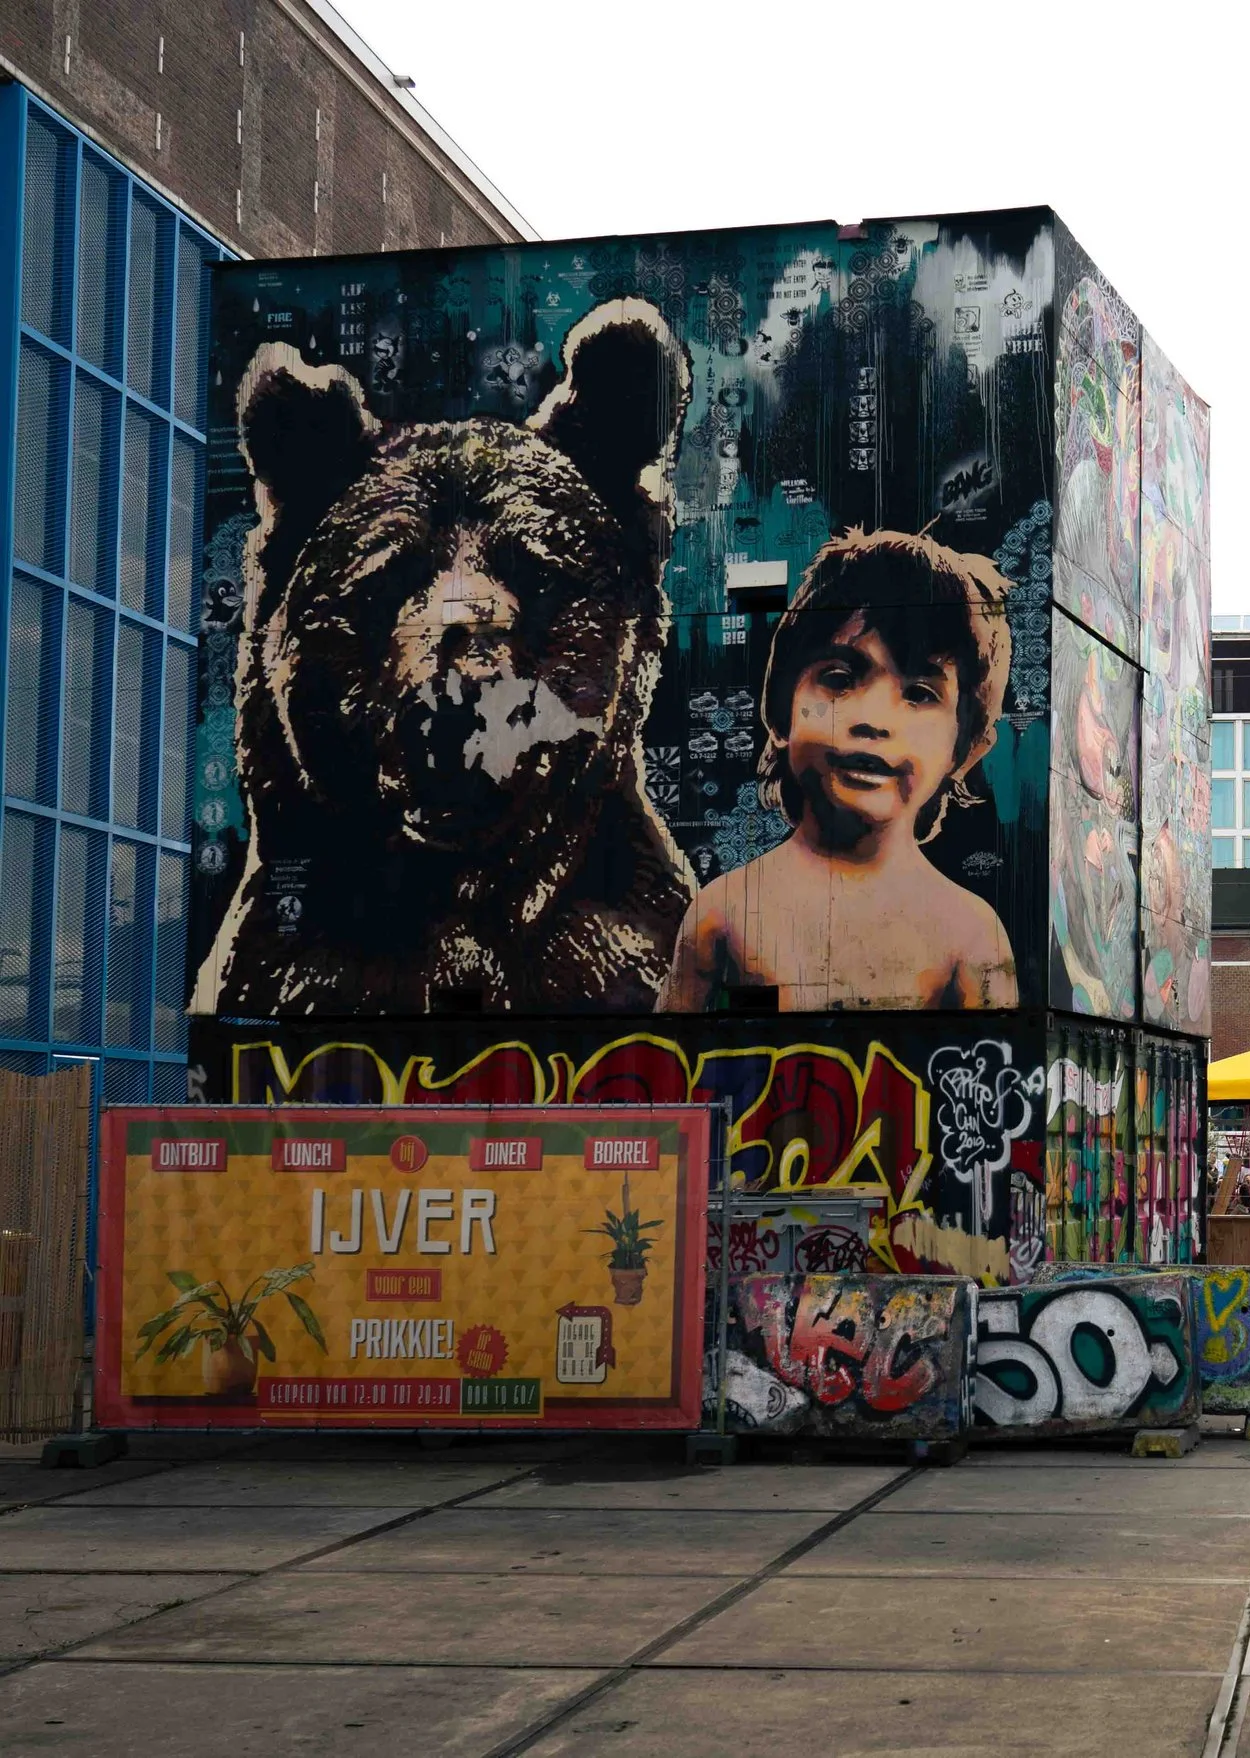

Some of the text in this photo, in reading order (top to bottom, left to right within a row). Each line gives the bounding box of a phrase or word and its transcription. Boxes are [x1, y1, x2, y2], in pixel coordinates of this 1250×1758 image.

[267, 312, 293, 323] FIRE
[159, 1142, 219, 1167] ONTBIJT
[283, 1143, 332, 1166] LUNCH
[484, 1142, 527, 1165] DINER
[593, 1141, 650, 1164] BORREL
[311, 1188, 496, 1254] IJVER
[350, 1318, 454, 1359] PRIKKIE!
